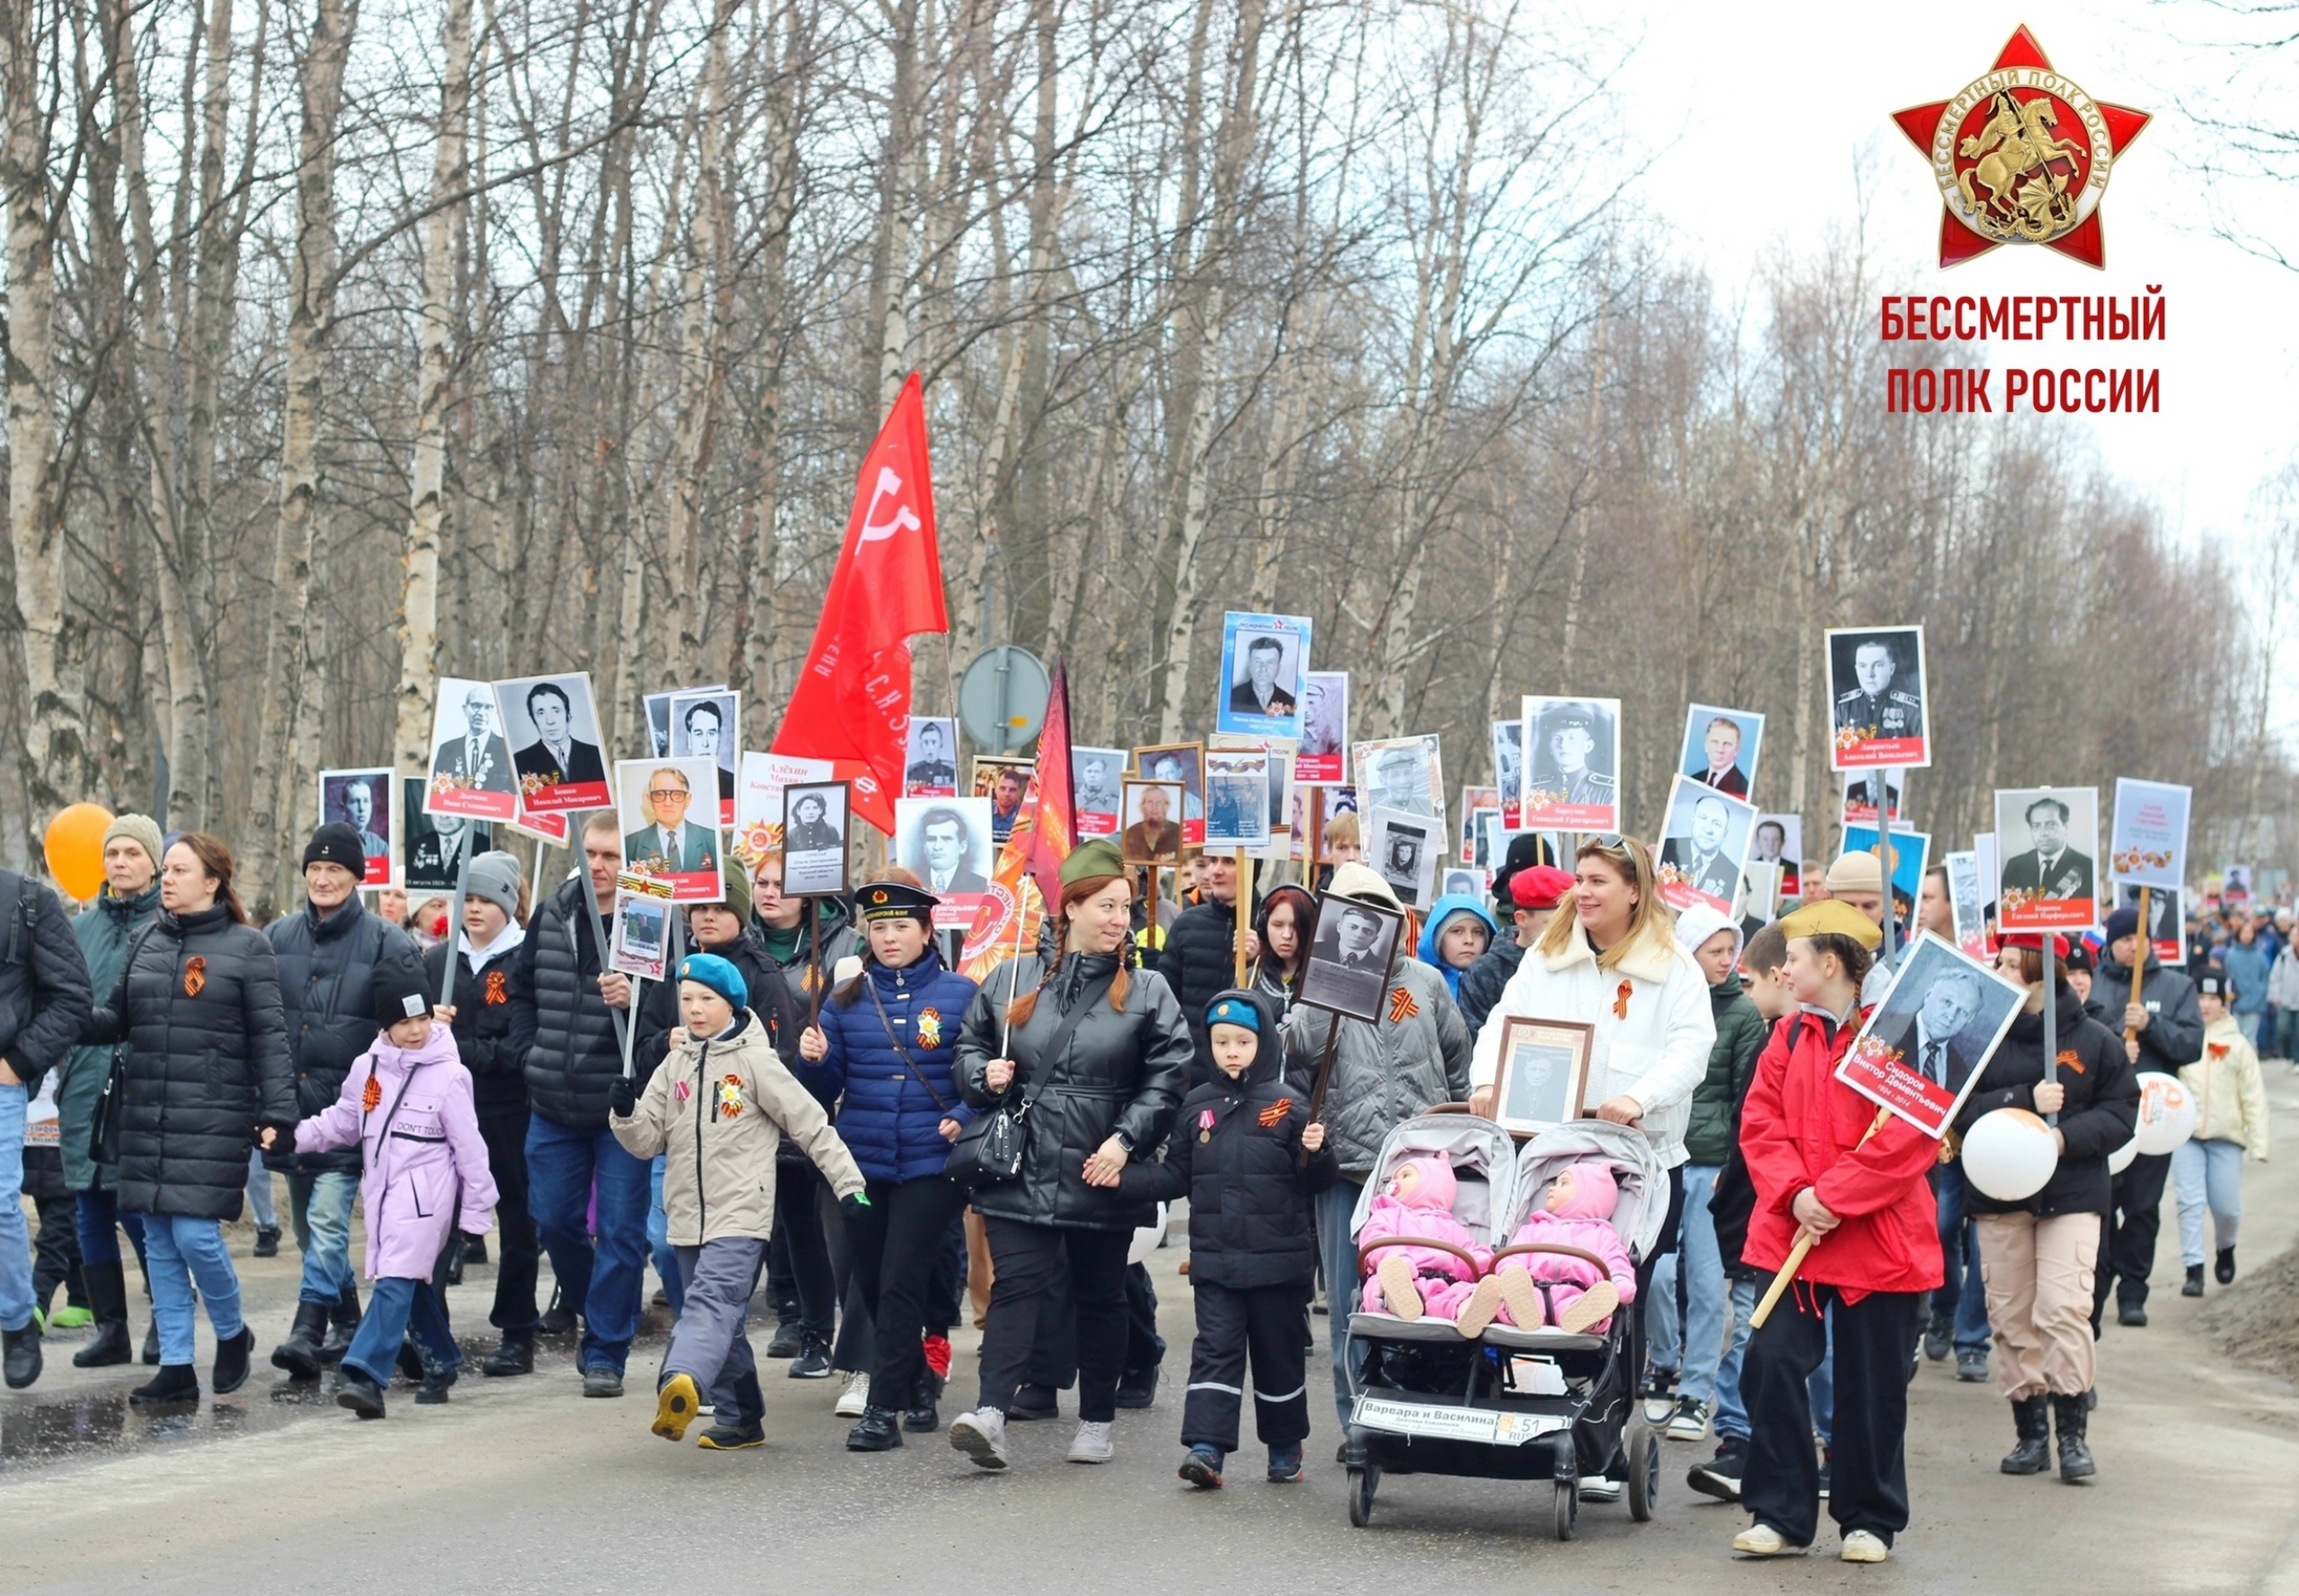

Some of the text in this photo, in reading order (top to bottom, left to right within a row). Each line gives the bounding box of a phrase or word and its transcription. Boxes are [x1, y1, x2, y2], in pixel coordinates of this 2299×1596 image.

[767, 763, 808, 776] Алёхин
[749, 780, 783, 792] Констан
[462, 801, 501, 812] Степанович
[563, 795, 602, 804] Макарович
[1885, 1061, 1926, 1091] Сидоров
[1852, 1054, 1948, 1116] Виктор Дементьевич
[1877, 1084, 1892, 1096] 1924
[1895, 1095, 1912, 1107] 2014
[396, 1122, 421, 1134] DON'T
[1365, 1403, 1495, 1425] Варвара и Василина
[1520, 1418, 1540, 1433] 51
